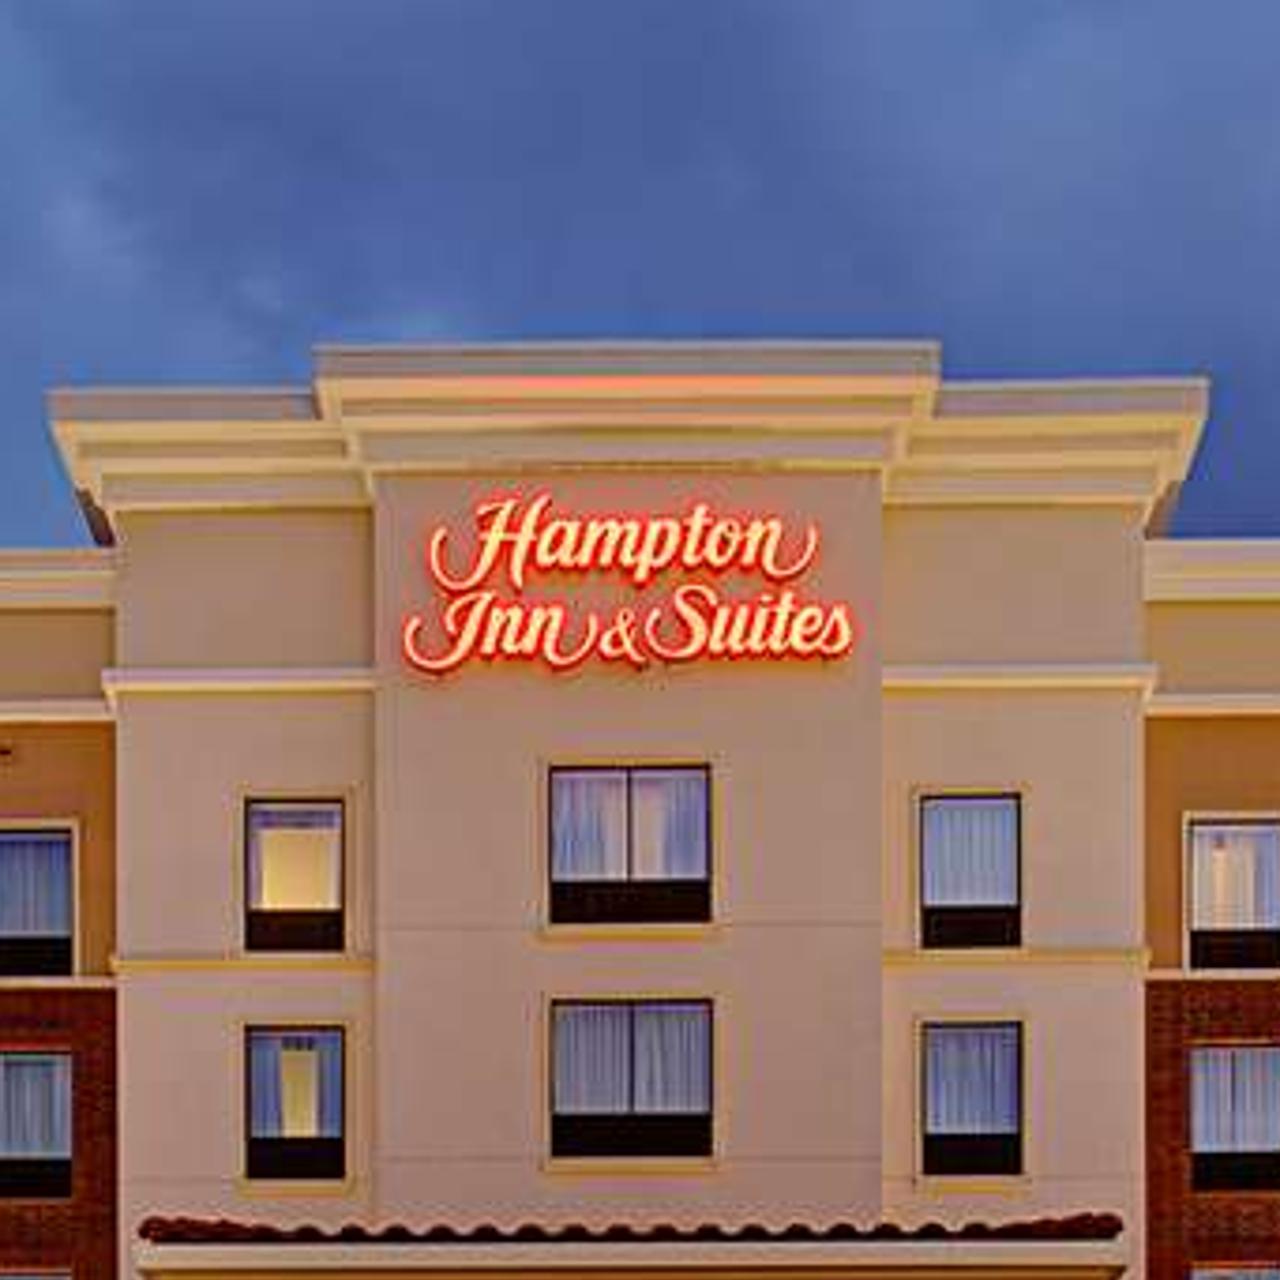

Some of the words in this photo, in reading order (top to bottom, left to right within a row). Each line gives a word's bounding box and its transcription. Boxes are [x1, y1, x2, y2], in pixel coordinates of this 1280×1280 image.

[430, 495, 817, 590] Hampton
[404, 590, 598, 667] Inn
[600, 609, 646, 662] &
[644, 585, 852, 660] Suites
